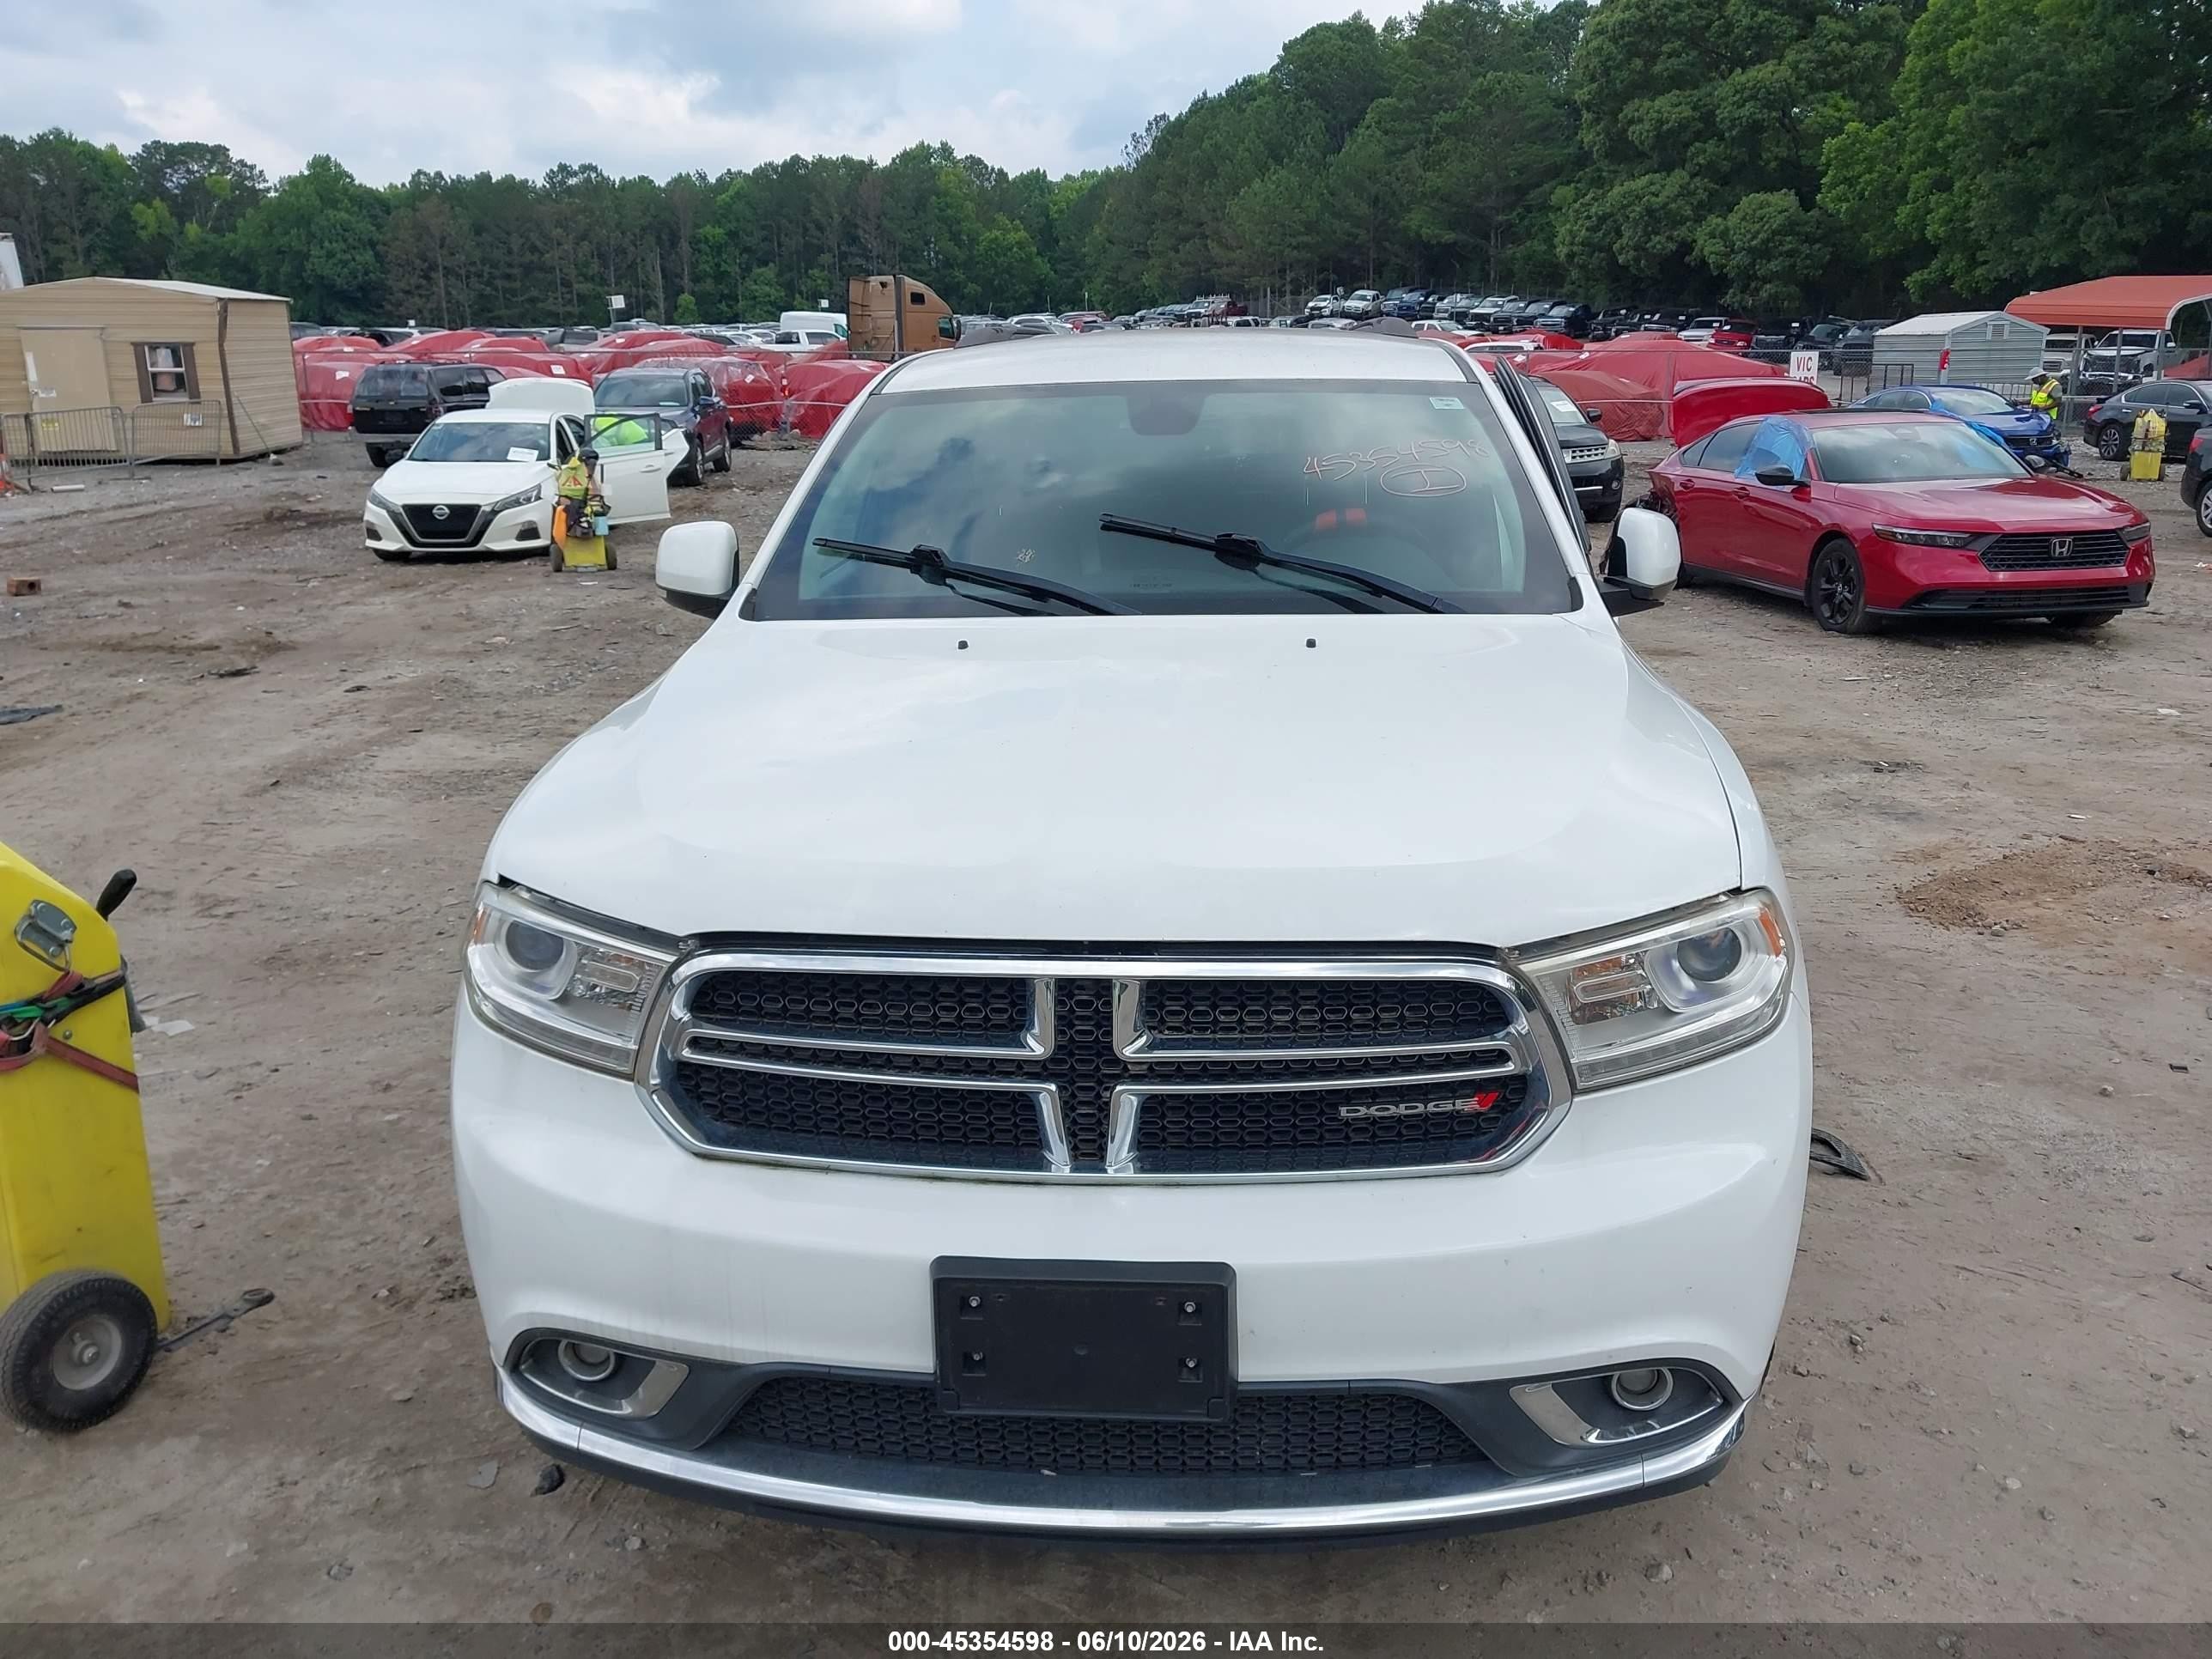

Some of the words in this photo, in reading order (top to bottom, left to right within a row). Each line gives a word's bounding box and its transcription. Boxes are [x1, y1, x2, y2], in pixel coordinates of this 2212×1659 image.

[1796, 356, 1813, 372] VIC
[1303, 439, 1490, 481] 45354598
[1339, 1097, 1479, 1117] DODGE
